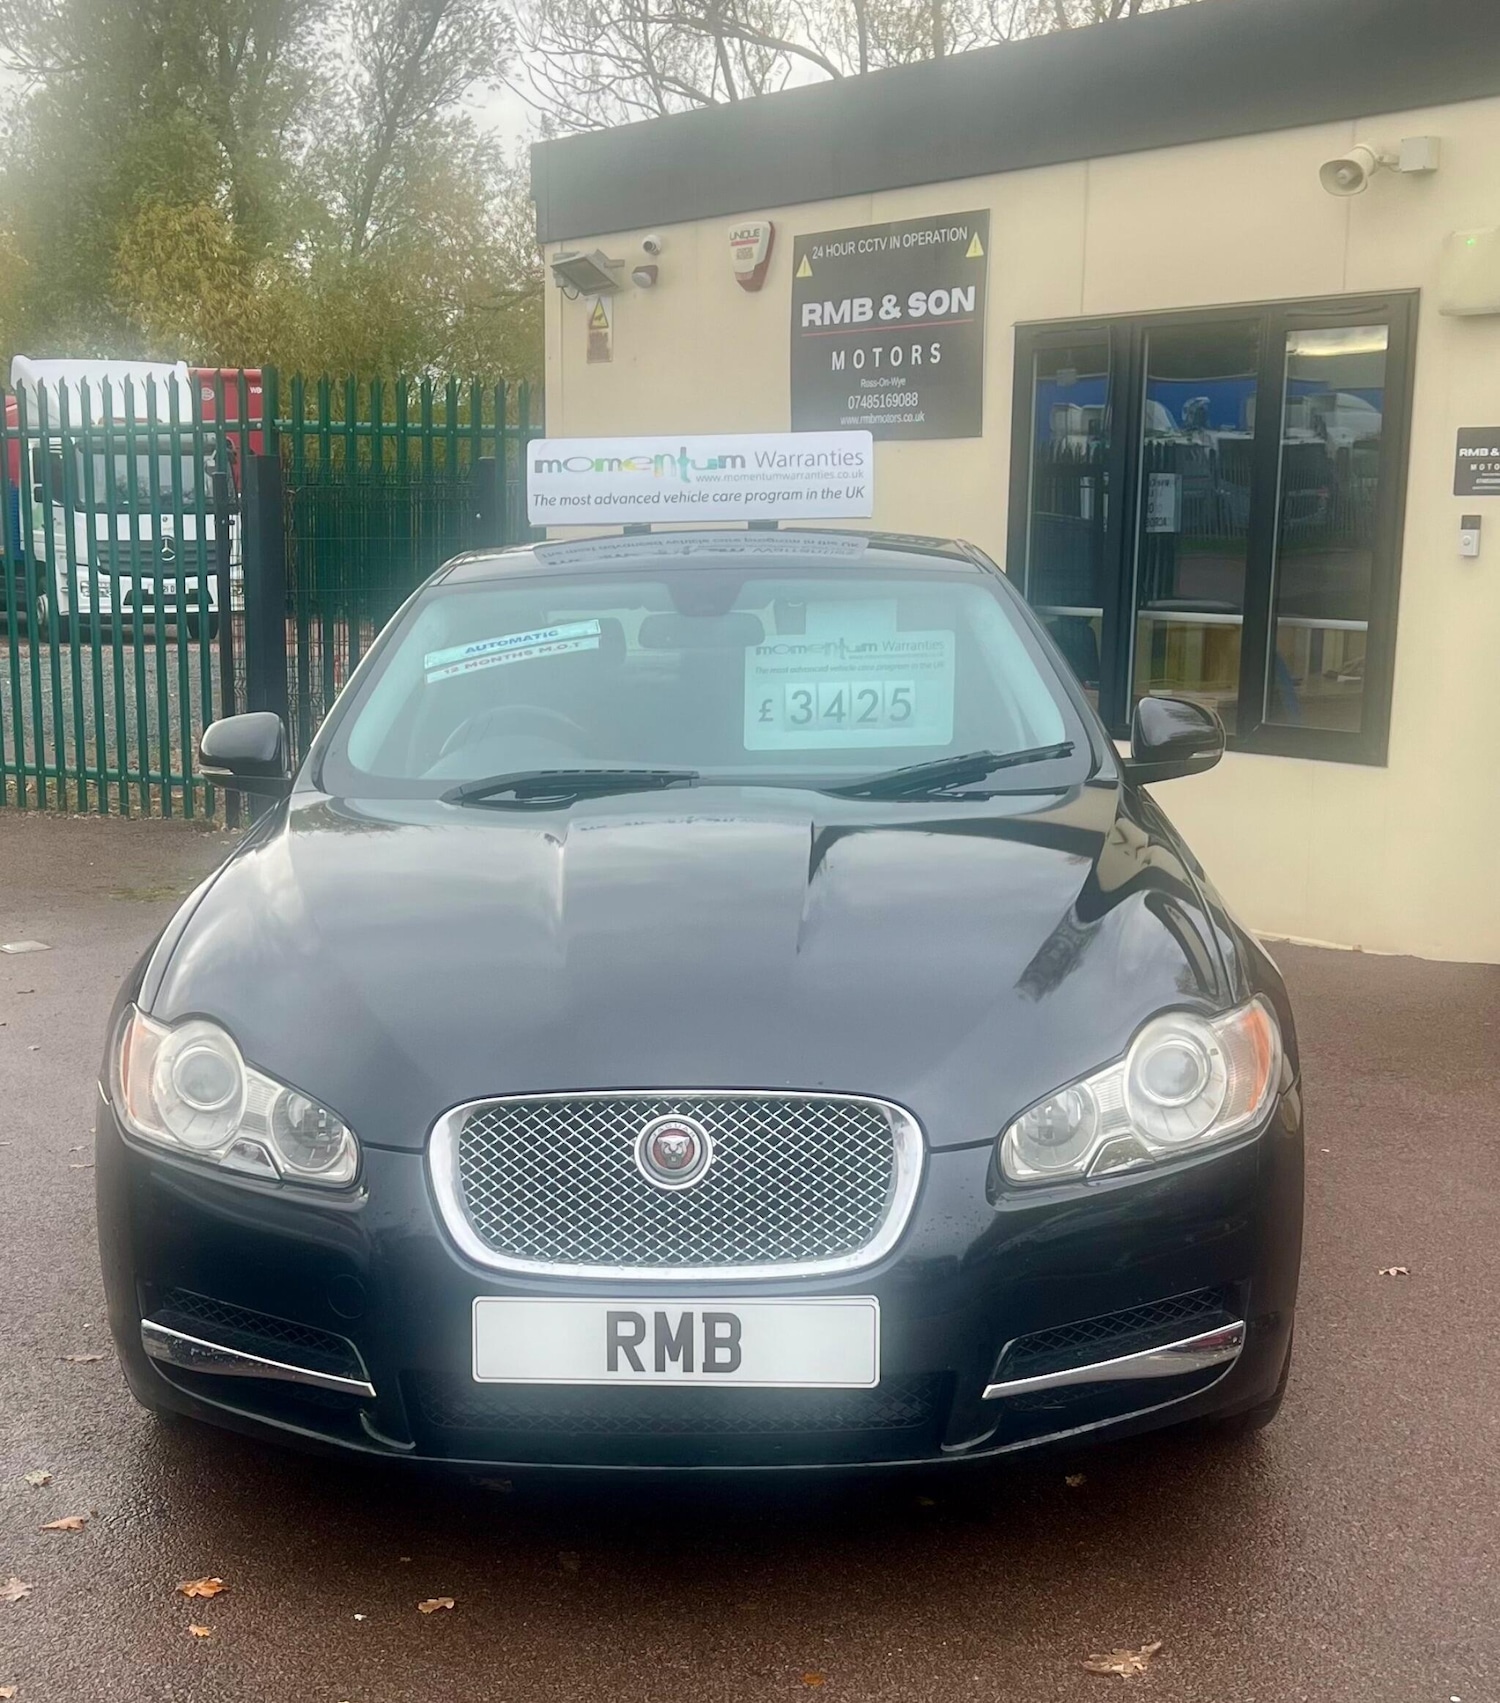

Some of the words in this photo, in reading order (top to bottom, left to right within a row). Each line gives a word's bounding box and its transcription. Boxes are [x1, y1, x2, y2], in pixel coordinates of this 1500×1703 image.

[729, 228, 761, 241] UNIQUE
[812, 246, 824, 259] 24
[825, 241, 856, 258] HOUR
[858, 237, 889, 254] CCTV
[889, 235, 901, 249] IN
[902, 226, 968, 247] OPERATION
[801, 297, 873, 327] RMB
[878, 294, 902, 320] &
[908, 286, 976, 318] SON
[831, 343, 941, 370] MOTORS
[860, 376, 906, 388] Ross-On-Wye
[848, 392, 918, 409] 07485169088
[840, 412, 925, 425] www.rmbmotors.co.uk
[1459, 448, 1489, 456] RMB
[1490, 448, 1500, 456] &
[534, 447, 746, 483] momentum
[754, 449, 864, 469] Warranties
[696, 470, 864, 483] www.momentumwarranties.co.uk
[533, 494, 557, 507] The
[559, 495, 592, 506] most
[594, 492, 661, 505] advanced
[663, 490, 709, 504] vehicle
[712, 492, 742, 502] care
[744, 490, 803, 506] program
[805, 487, 818, 499] in
[821, 487, 843, 499] the
[845, 485, 865, 499] UK
[465, 630, 559, 654] AUTOMATIC
[755, 638, 877, 660] momentum
[882, 640, 944, 651] Warranties
[465, 650, 533, 670] MONTHS
[607, 1311, 741, 1373] RMB
